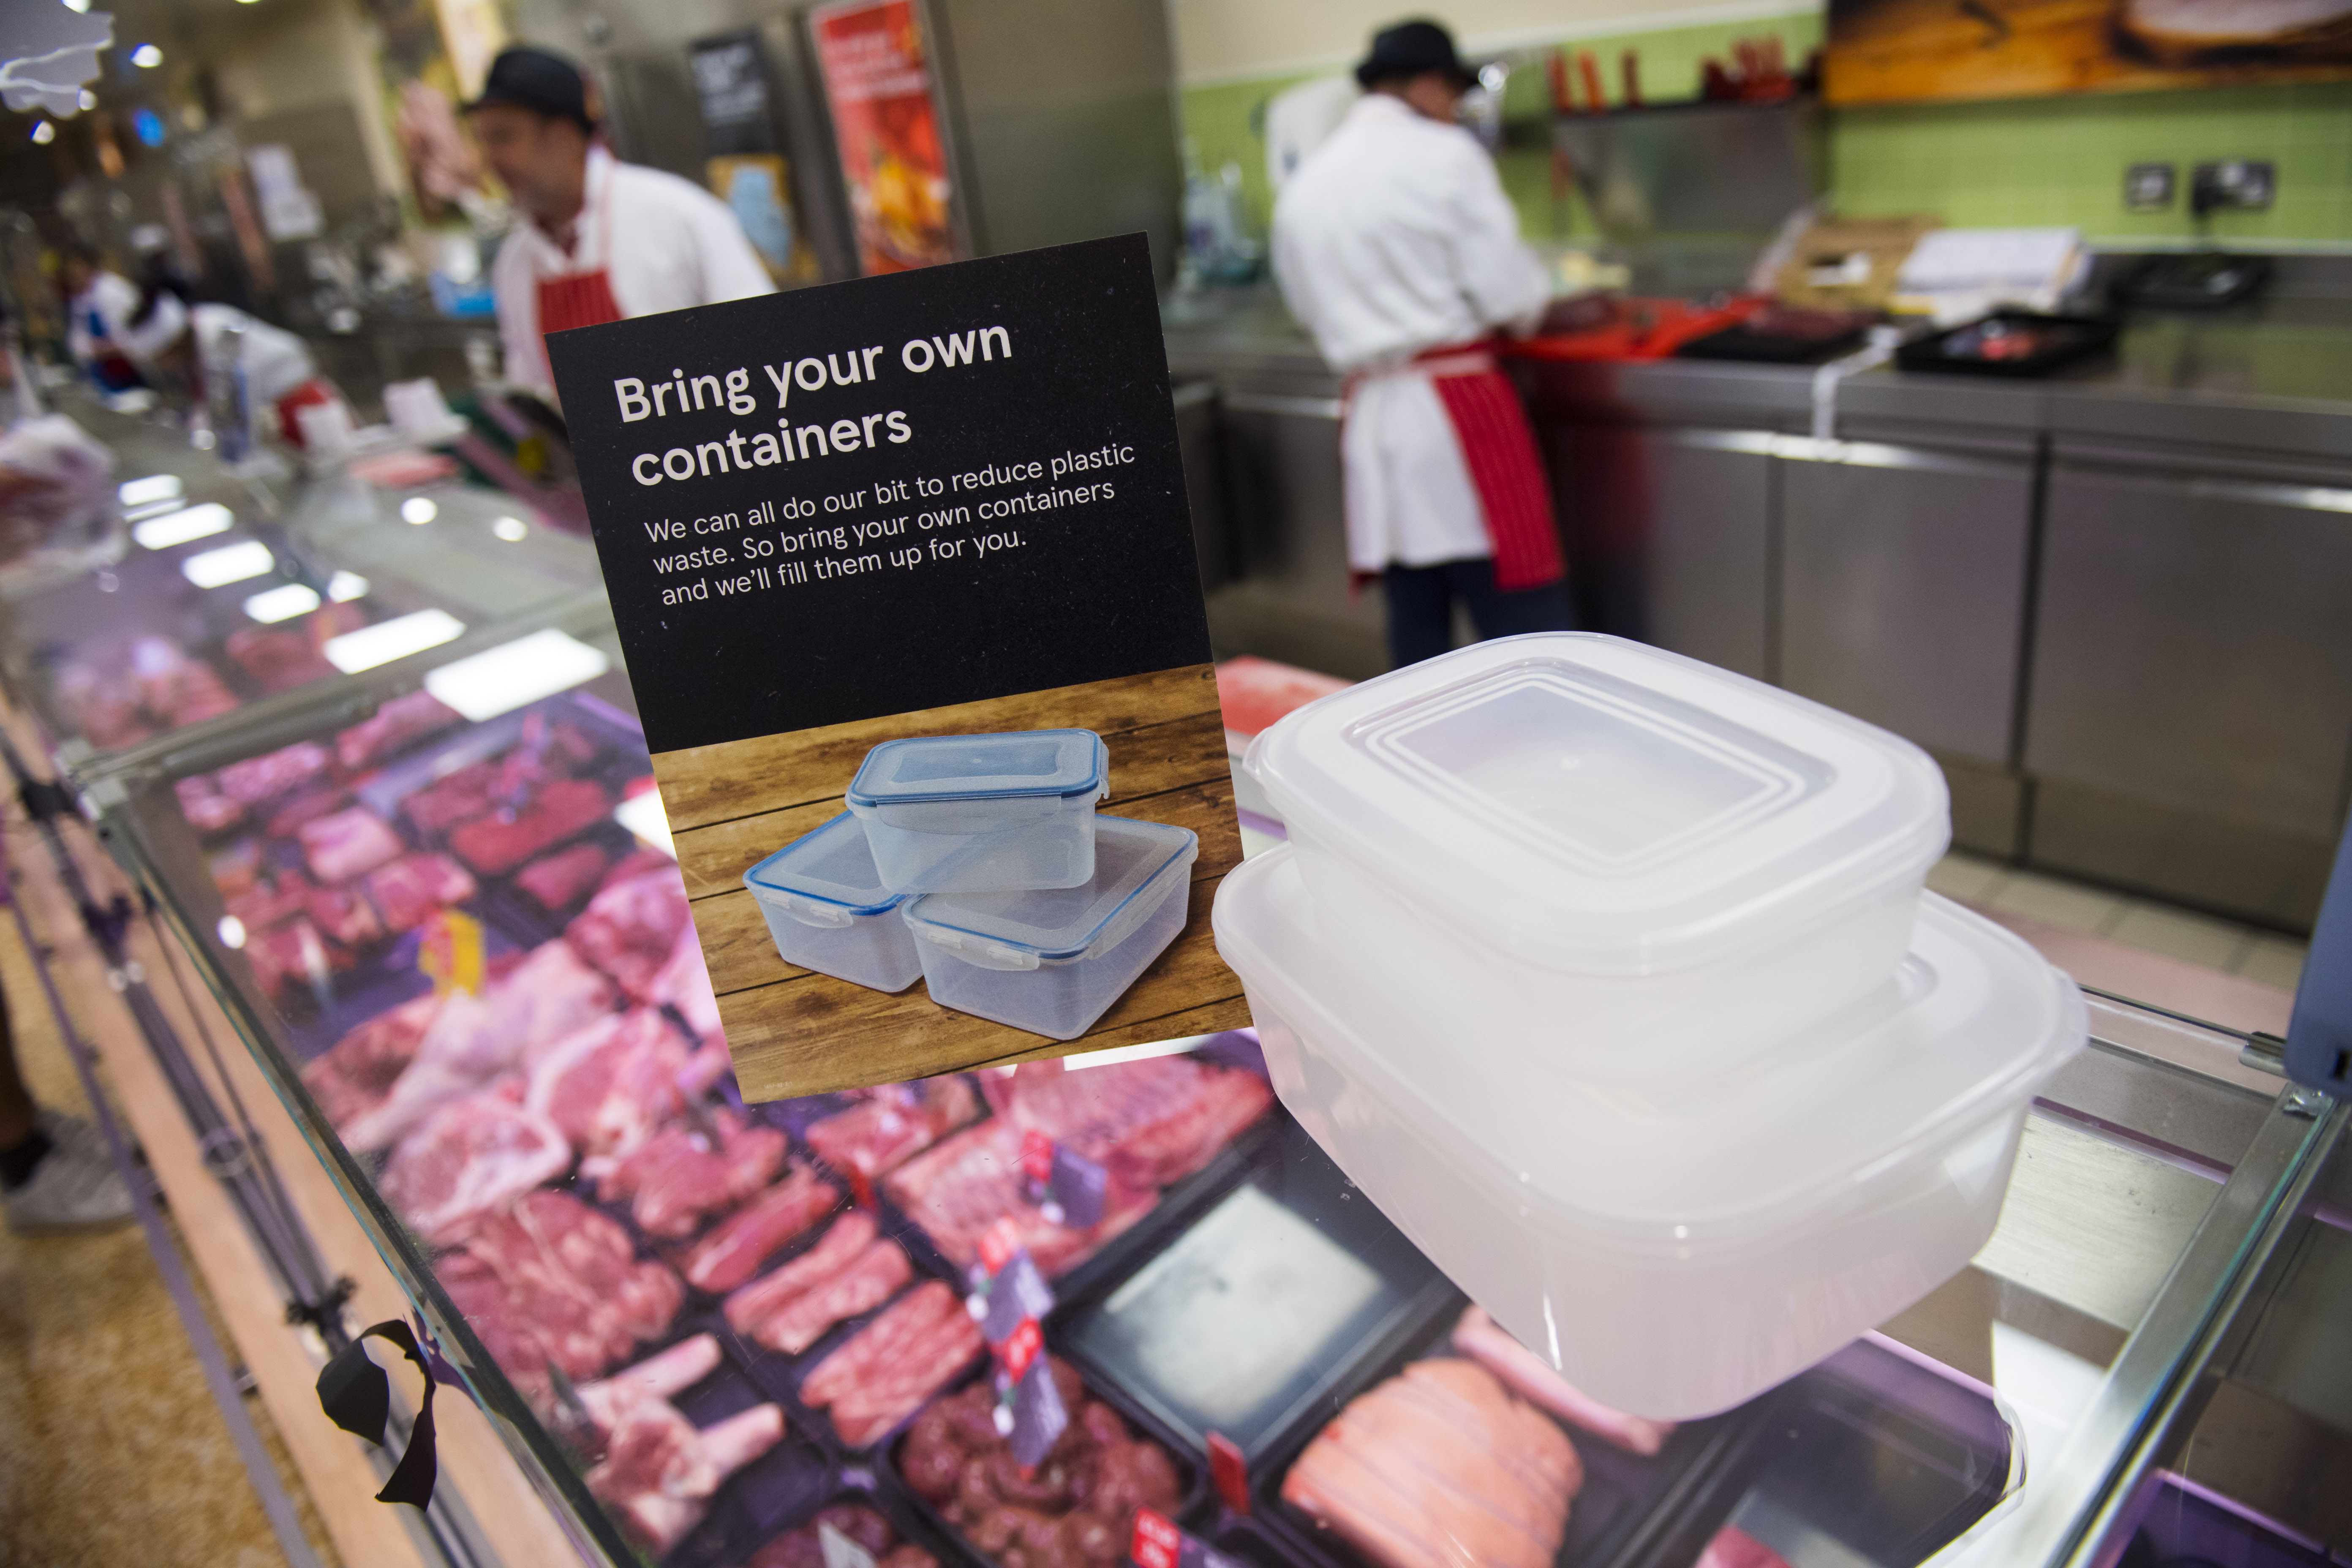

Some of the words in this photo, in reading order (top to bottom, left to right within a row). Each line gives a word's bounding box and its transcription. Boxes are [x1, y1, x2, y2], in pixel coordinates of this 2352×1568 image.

[613, 366, 757, 423] Bring
[763, 345, 884, 409] your
[901, 326, 1012, 373] own
[632, 410, 912, 486] containers
[643, 518, 687, 543] We
[694, 512, 740, 535] can
[747, 501, 776, 526] all
[783, 496, 816, 520] do
[823, 490, 867, 513] our
[874, 479, 911, 505] bit
[915, 476, 944, 497] to
[951, 461, 1043, 492] reduce
[1051, 443, 1135, 481] plastic
[652, 546, 735, 574] waste.
[742, 537, 774, 559] So
[780, 525, 849, 553] bring
[851, 516, 909, 547] your
[917, 506, 971, 530] own
[978, 482, 1115, 520] containers
[662, 577, 709, 606] and
[714, 567, 771, 596] we’ll
[777, 561, 808, 586] fill
[813, 554, 882, 580] them
[889, 547, 922, 571] up
[928, 538, 966, 561] for
[972, 531, 1026, 559] you.
